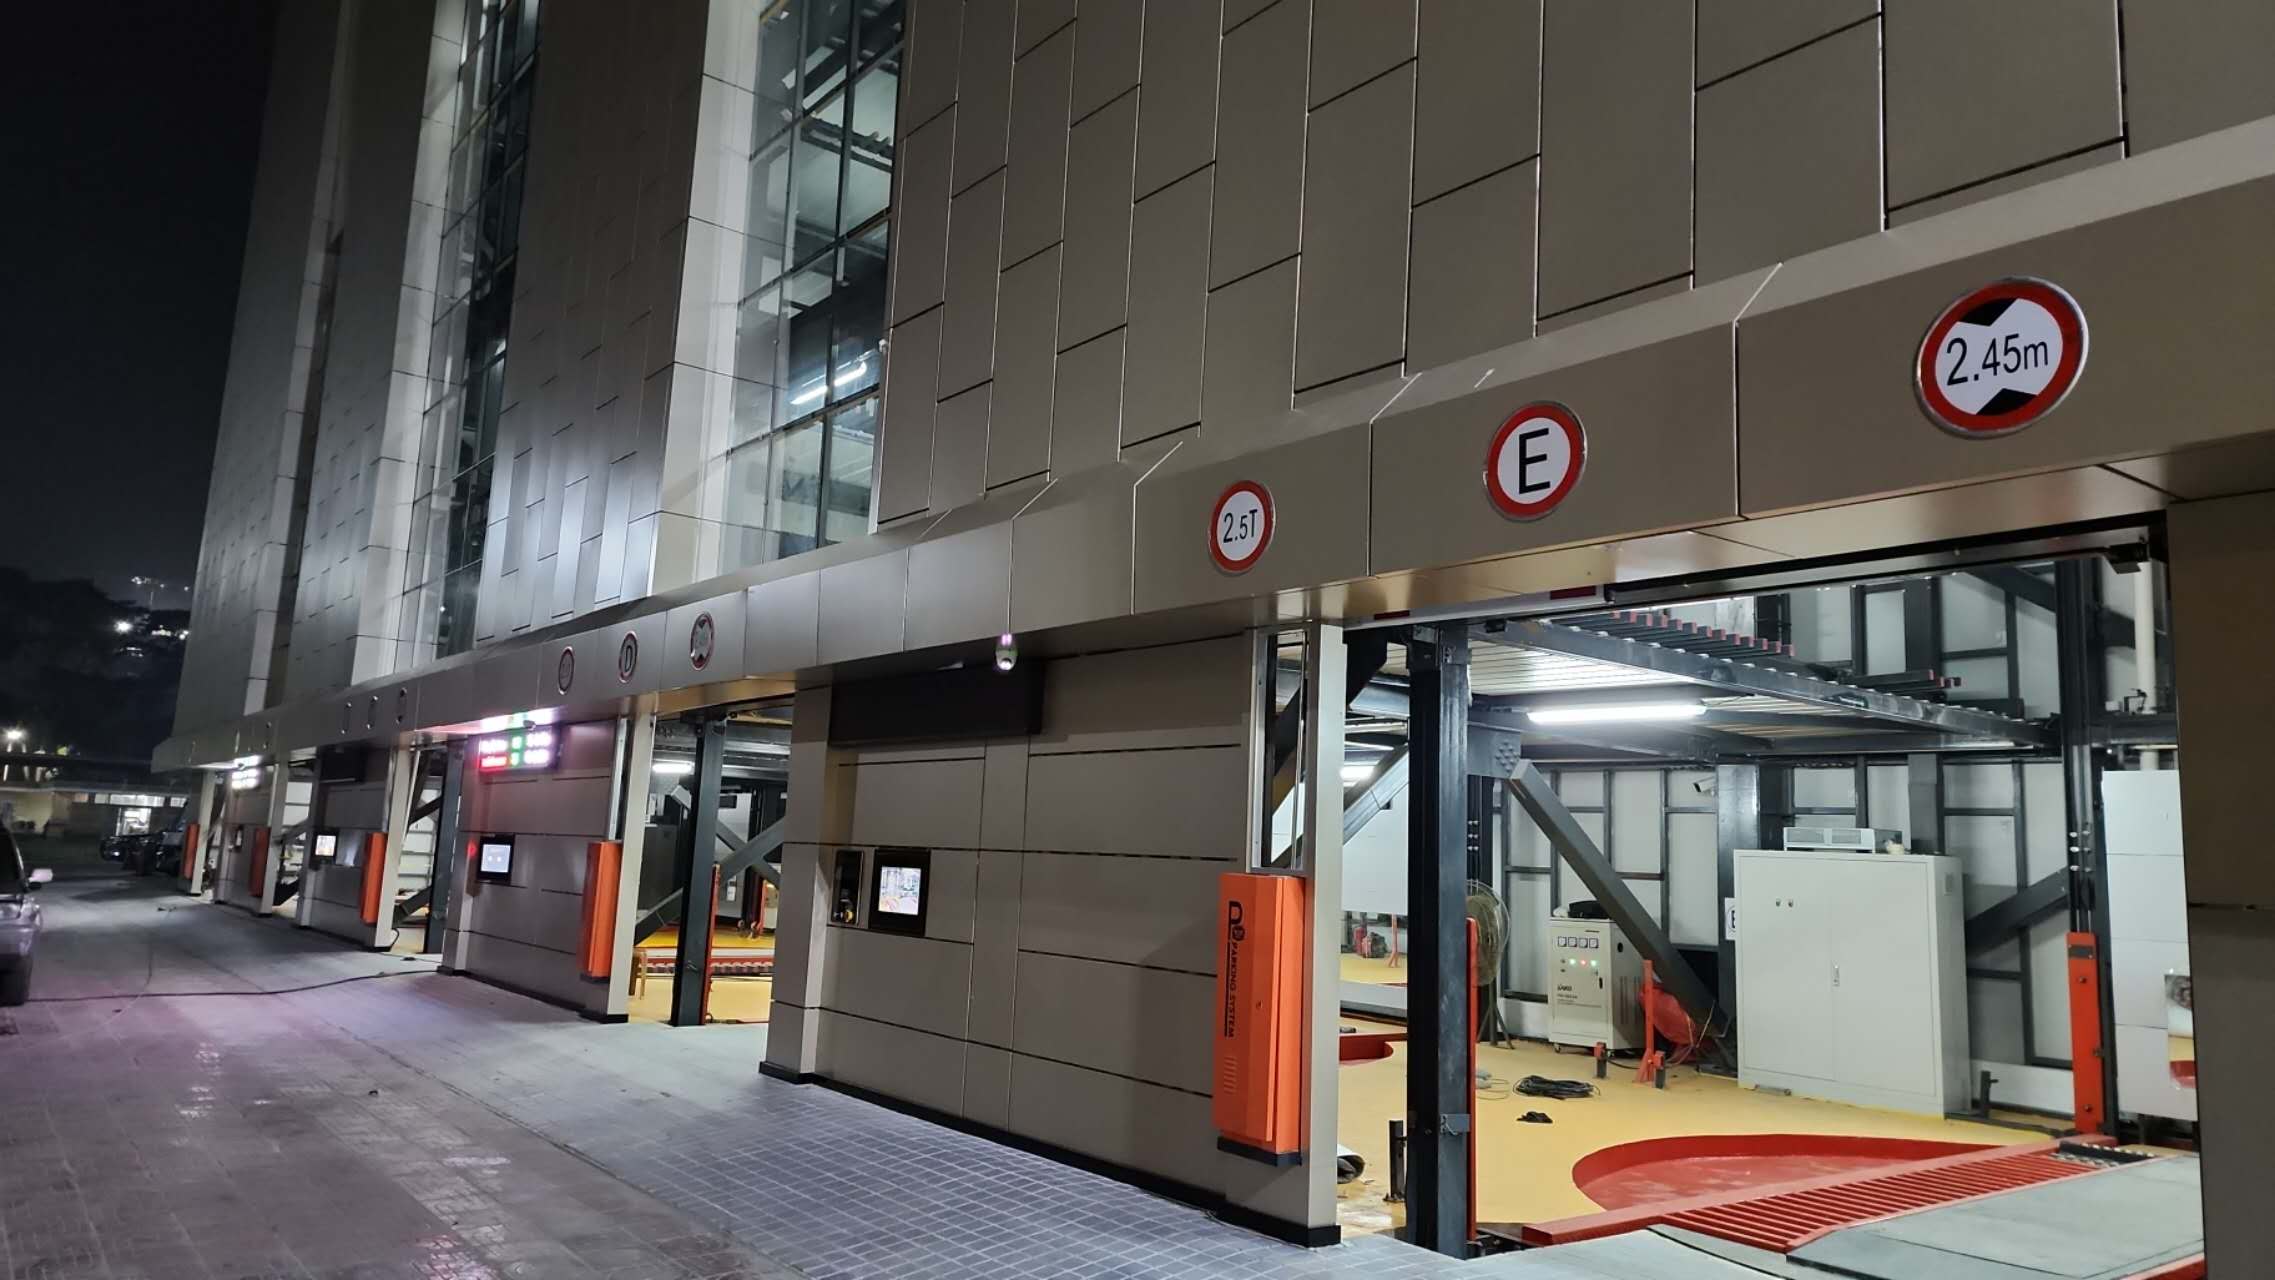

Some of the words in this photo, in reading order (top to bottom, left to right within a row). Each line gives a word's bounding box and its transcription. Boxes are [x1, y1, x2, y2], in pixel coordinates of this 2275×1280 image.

[1946, 333, 2049, 386] 2.45m
[1518, 427, 1552, 495] E
[1222, 508, 1258, 544] 2.5T
[1229, 942, 1239, 991] PARKING
[1227, 994, 1237, 1038] SYSTEM
